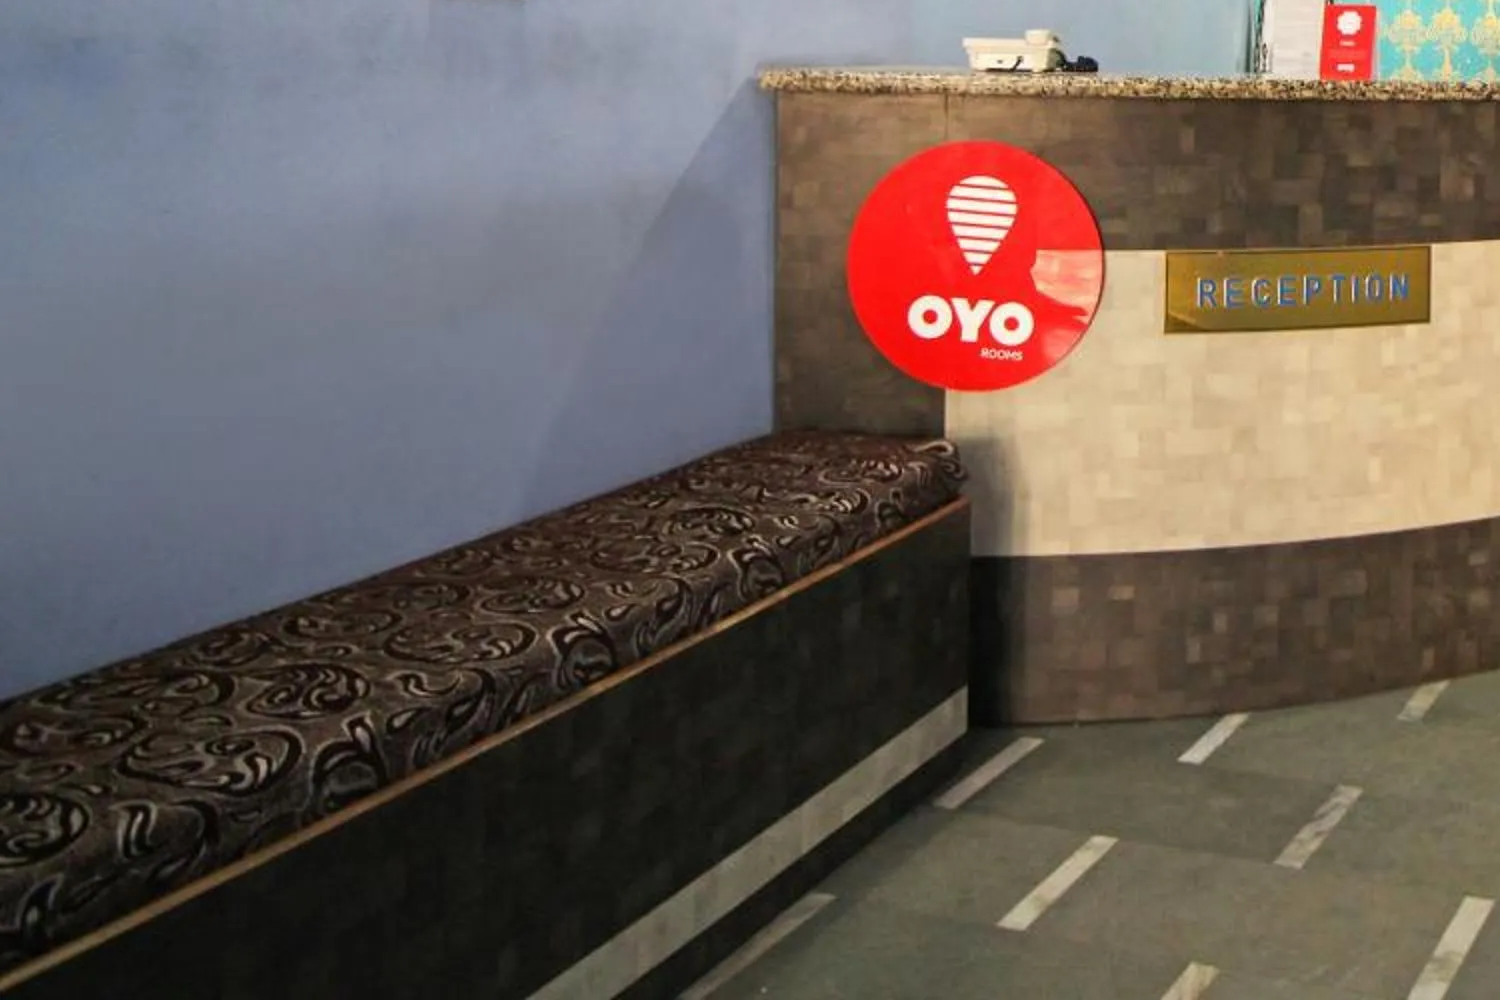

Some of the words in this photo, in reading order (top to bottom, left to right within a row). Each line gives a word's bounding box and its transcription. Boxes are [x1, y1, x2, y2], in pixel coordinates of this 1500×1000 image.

[1196, 273, 1409, 308] RECEPTION
[907, 295, 1035, 346] OYO
[980, 347, 1023, 361] ROOMS
